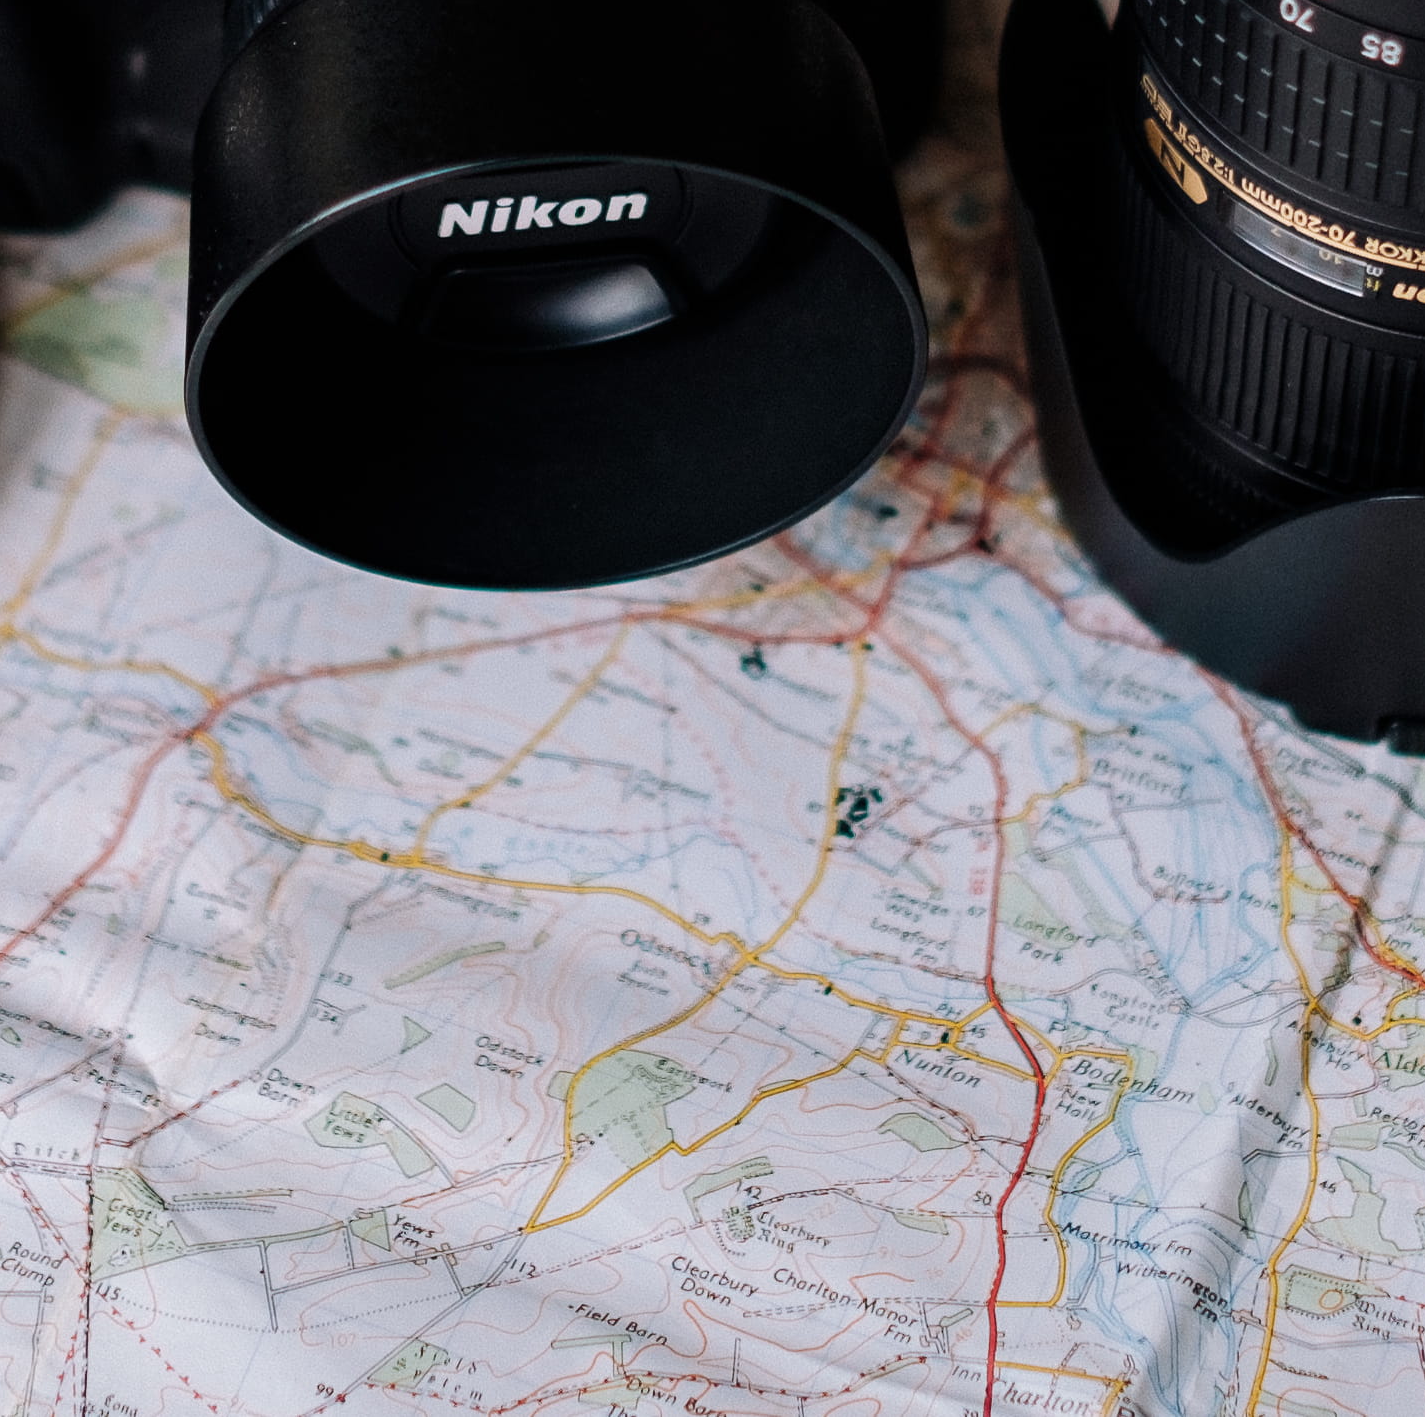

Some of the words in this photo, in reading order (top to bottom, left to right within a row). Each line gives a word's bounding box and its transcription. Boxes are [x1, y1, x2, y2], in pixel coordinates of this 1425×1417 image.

[1360, 33, 1404, 68] 85
[437, 193, 648, 238] Nikon
[1242, 176, 1356, 246] 70-200mm
[1012, 916, 1098, 948] Longford
[1018, 943, 1065, 965] Park
[476, 1035, 547, 1066] Odstock
[1285, 1018, 1366, 1062] Alderbury
[475, 1054, 525, 1079] Down
[895, 1049, 981, 1088] Nunton
[1073, 1058, 1195, 1105] Bodenham
[1229, 1093, 1309, 1137] Alderbury
[1277, 1132, 1304, 1151] Fm
[101, 1214, 143, 1238] Yews
[392, 1212, 435, 1239] Yews
[392, 1230, 421, 1250] Fm
[1061, 1222, 1163, 1259] Matrimony
[1166, 1239, 1192, 1257] Fm
[8, 1240, 65, 1270] Round
[0, 1256, 55, 1288] Clump
[671, 1256, 759, 1296] Clearbury
[1116, 1261, 1229, 1311] Witherington
[680, 1279, 733, 1307] Down
[773, 1268, 855, 1303] Charlton
[861, 1298, 919, 1328] Manor
[575, 1304, 619, 1330] Field
[622, 1319, 668, 1347] Barn
[1192, 1299, 1219, 1322] Fm
[882, 1323, 911, 1346] Fm
[951, 1363, 981, 1383] Inn
[316, 1383, 335, 1400] 99
[625, 1378, 676, 1407] Down
